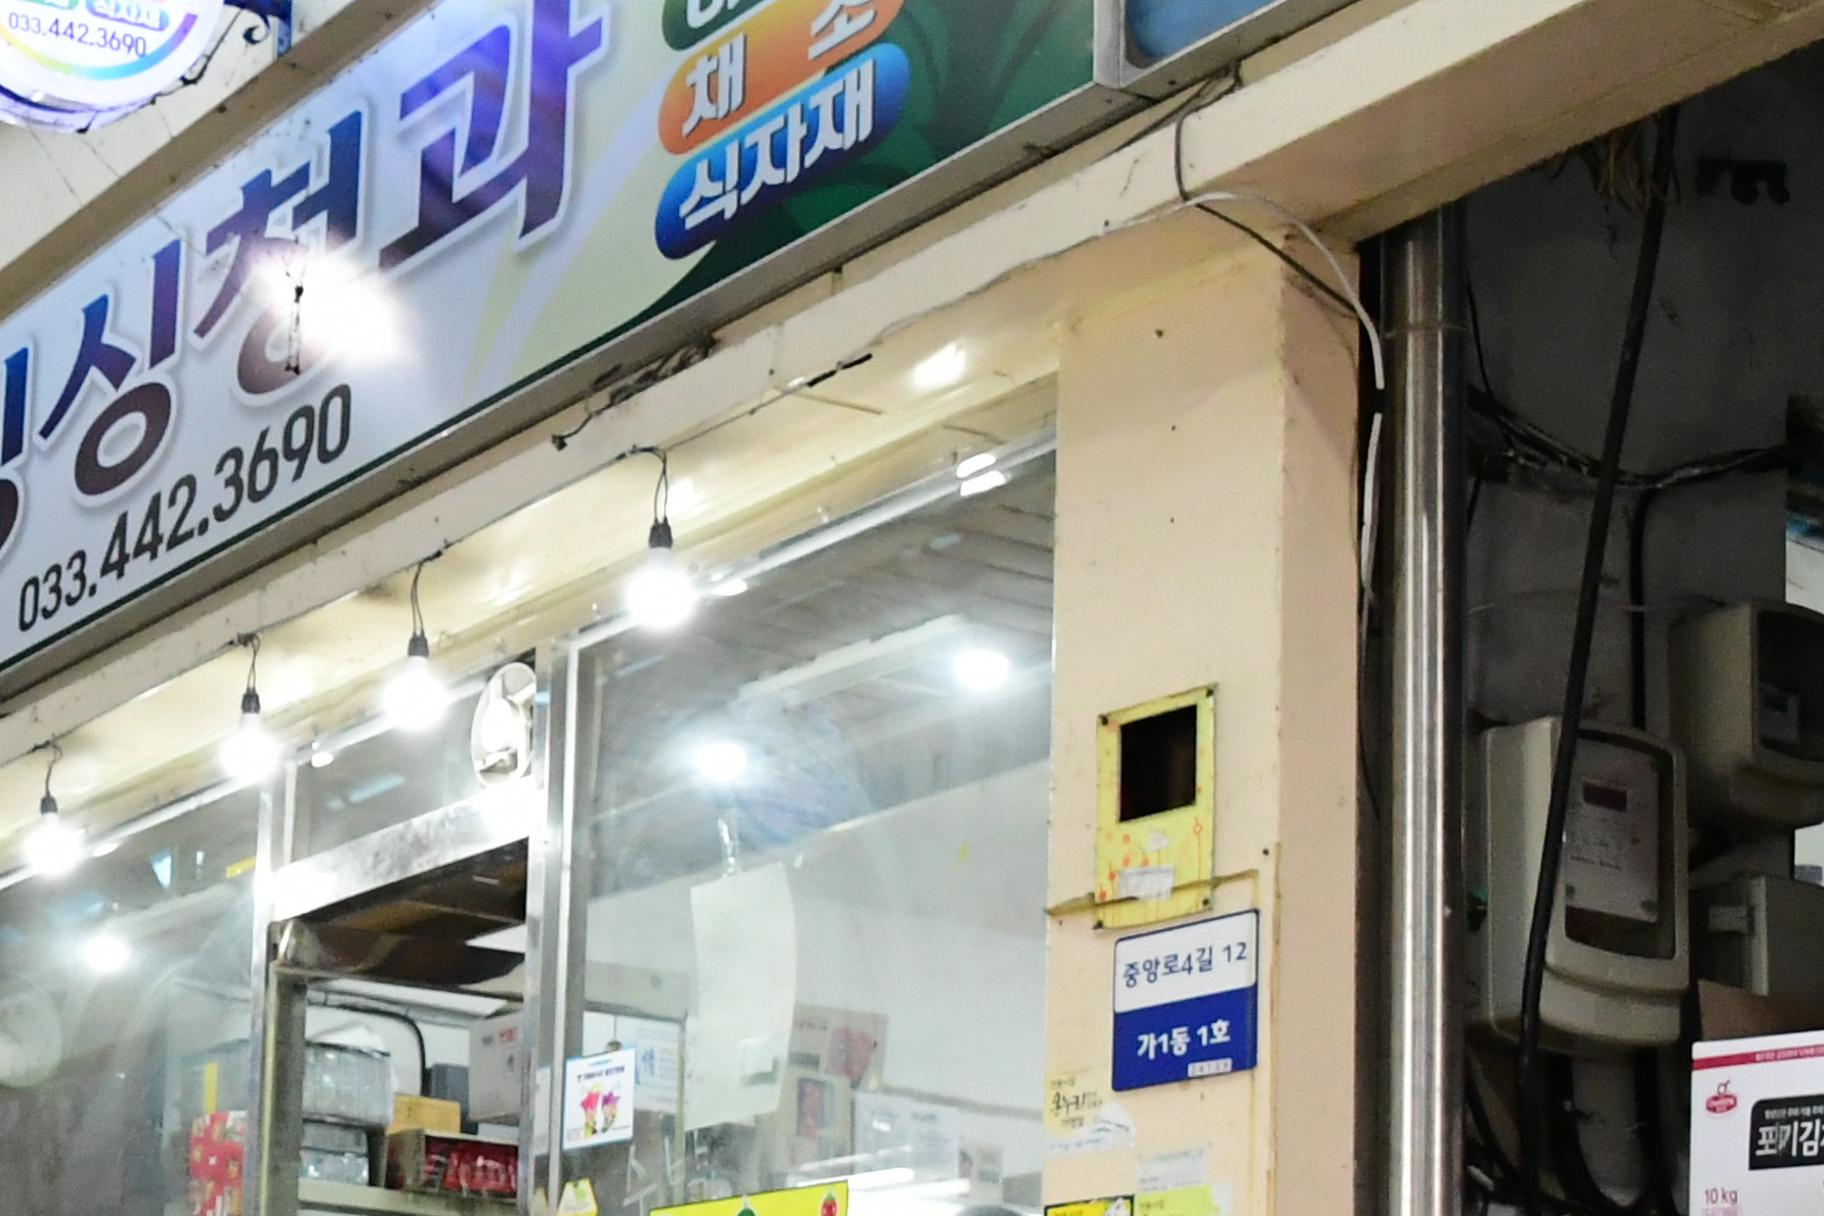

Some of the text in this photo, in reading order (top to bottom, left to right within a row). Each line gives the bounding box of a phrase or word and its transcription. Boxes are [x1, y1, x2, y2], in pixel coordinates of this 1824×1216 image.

[8, 11, 147, 57] 033.442.3690
[679, 58, 874, 230] 식자재
[17, 384, 353, 633] 033.442.3690
[1123, 941, 1247, 989] 중앙로4길 12
[1136, 1018, 1231, 1061] 가1동 1호
[1754, 1118, 1824, 1157] 포기김
[1704, 1186, 1738, 1205] 10 kg
